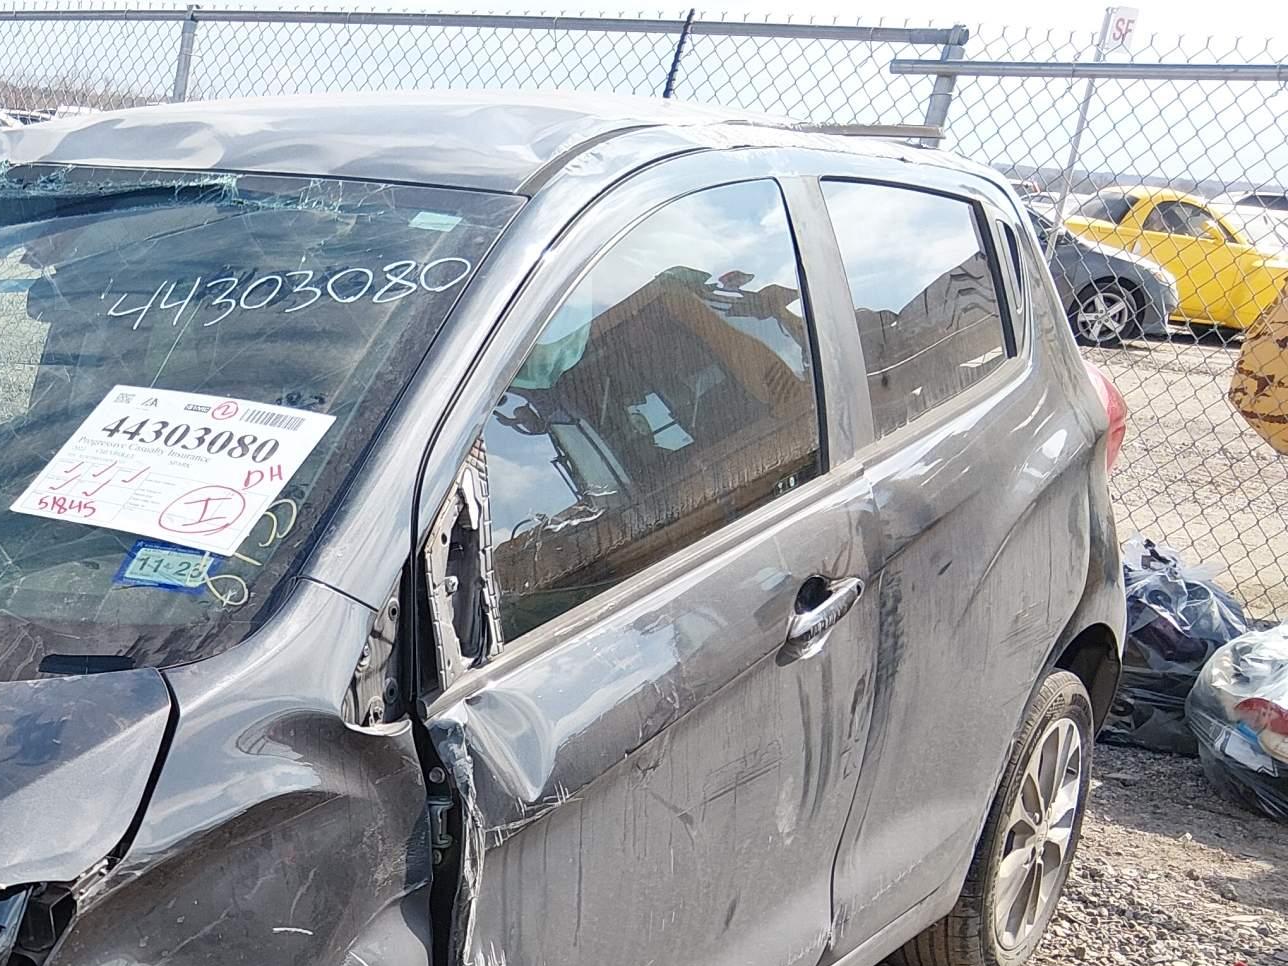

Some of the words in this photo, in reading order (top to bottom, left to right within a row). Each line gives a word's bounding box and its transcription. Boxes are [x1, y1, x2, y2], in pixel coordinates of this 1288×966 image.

[1112, 17, 1135, 42] SF
[107, 257, 473, 330] 44303080
[101, 415, 280, 464] 44303080
[128, 441, 164, 457] Casualty
[167, 448, 210, 464] Insurance
